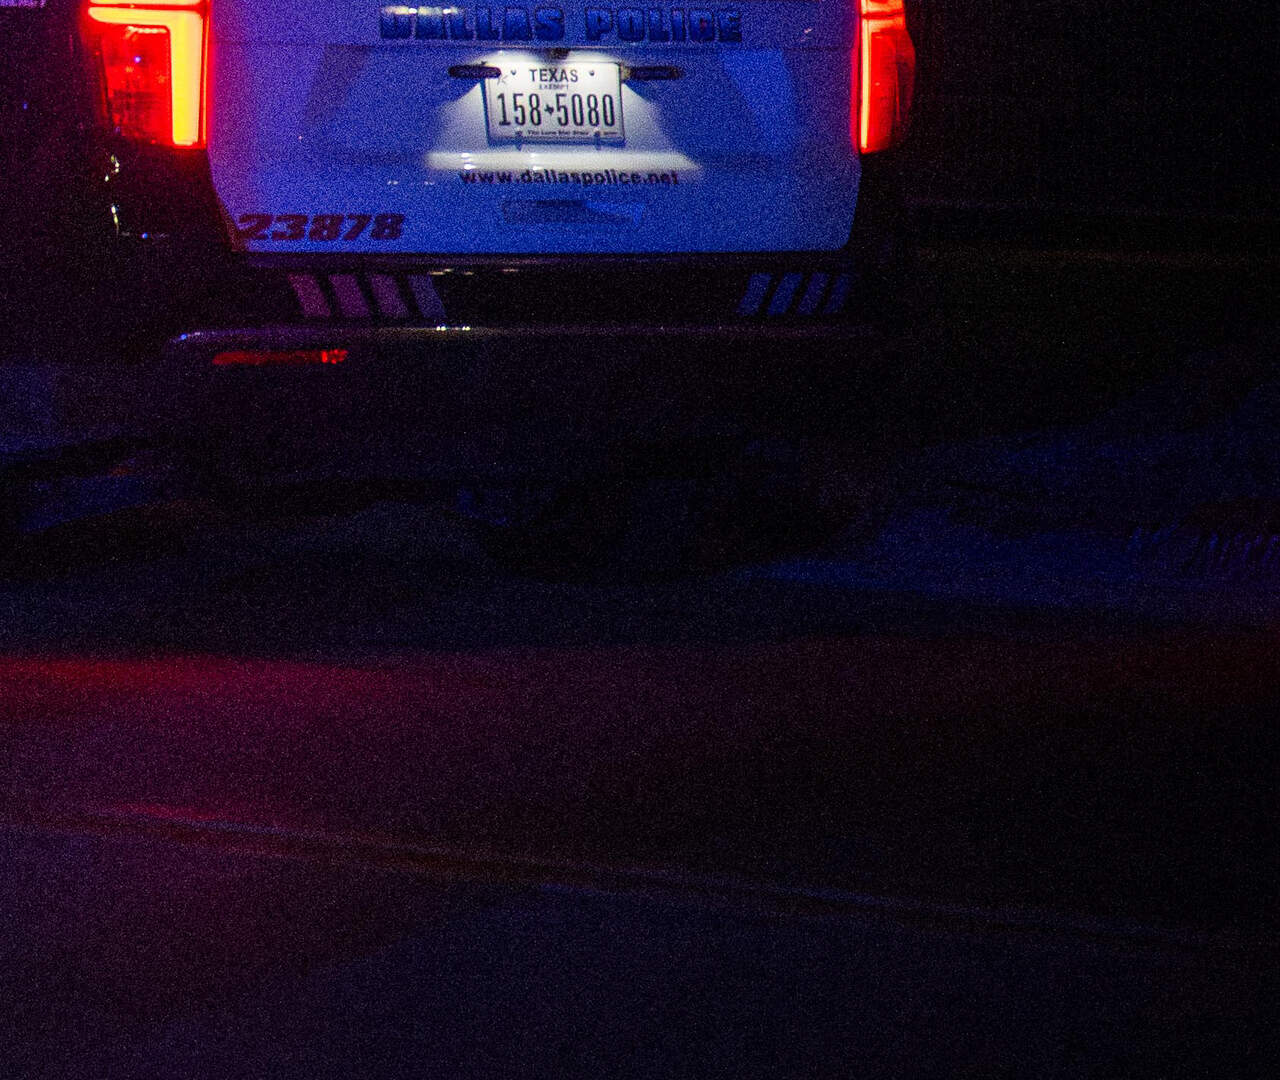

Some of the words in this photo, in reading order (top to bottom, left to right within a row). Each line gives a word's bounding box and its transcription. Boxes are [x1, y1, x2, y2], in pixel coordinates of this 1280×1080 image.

[379, 6, 565, 41] DALLAS
[585, 7, 741, 44] POLICE
[529, 69, 579, 83] TEXAS
[458, 168, 680, 186] www.dallaspolice.net
[238, 213, 404, 241] 23878
